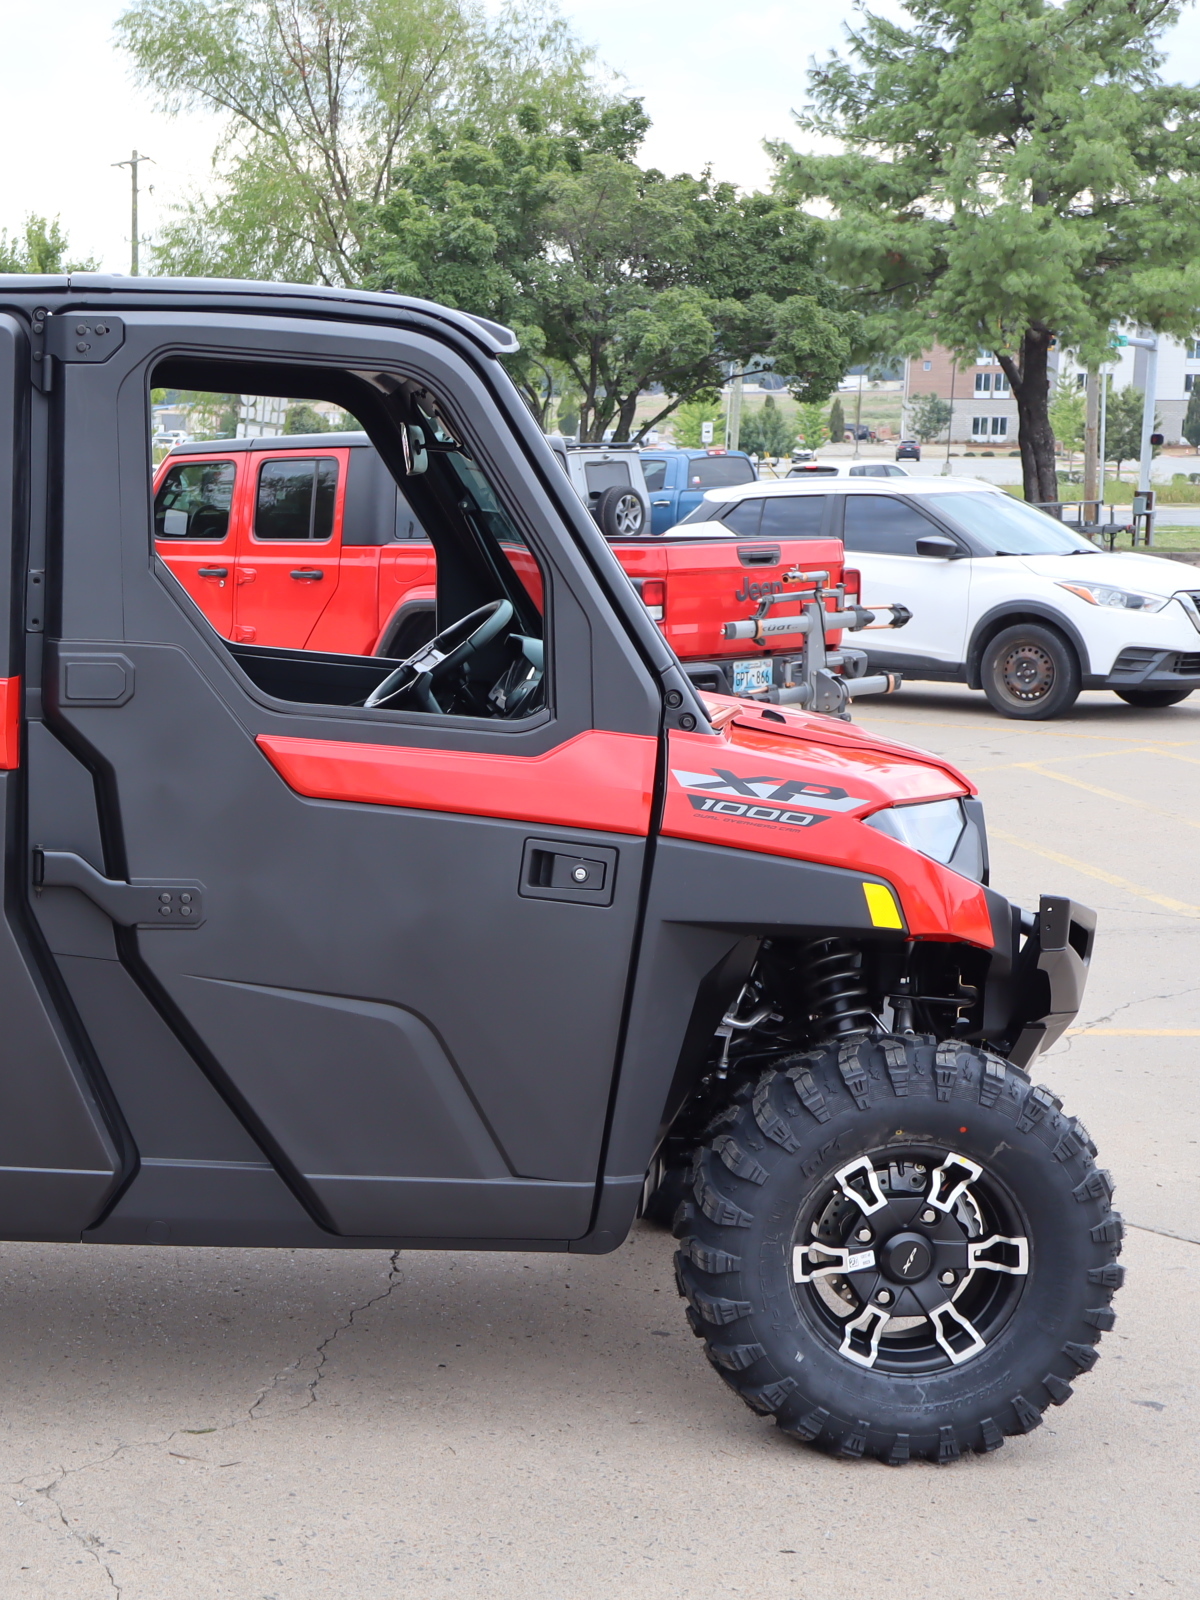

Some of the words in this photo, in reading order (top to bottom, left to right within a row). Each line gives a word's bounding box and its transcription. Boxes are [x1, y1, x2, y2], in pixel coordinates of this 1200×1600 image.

[686, 767, 850, 802] XP
[693, 812, 720, 821] DUAL
[723, 817, 777, 830] OVERHEAD
[779, 826, 802, 834] CAM
[701, 798, 814, 827] 1000
[903, 1247, 917, 1275] XP
